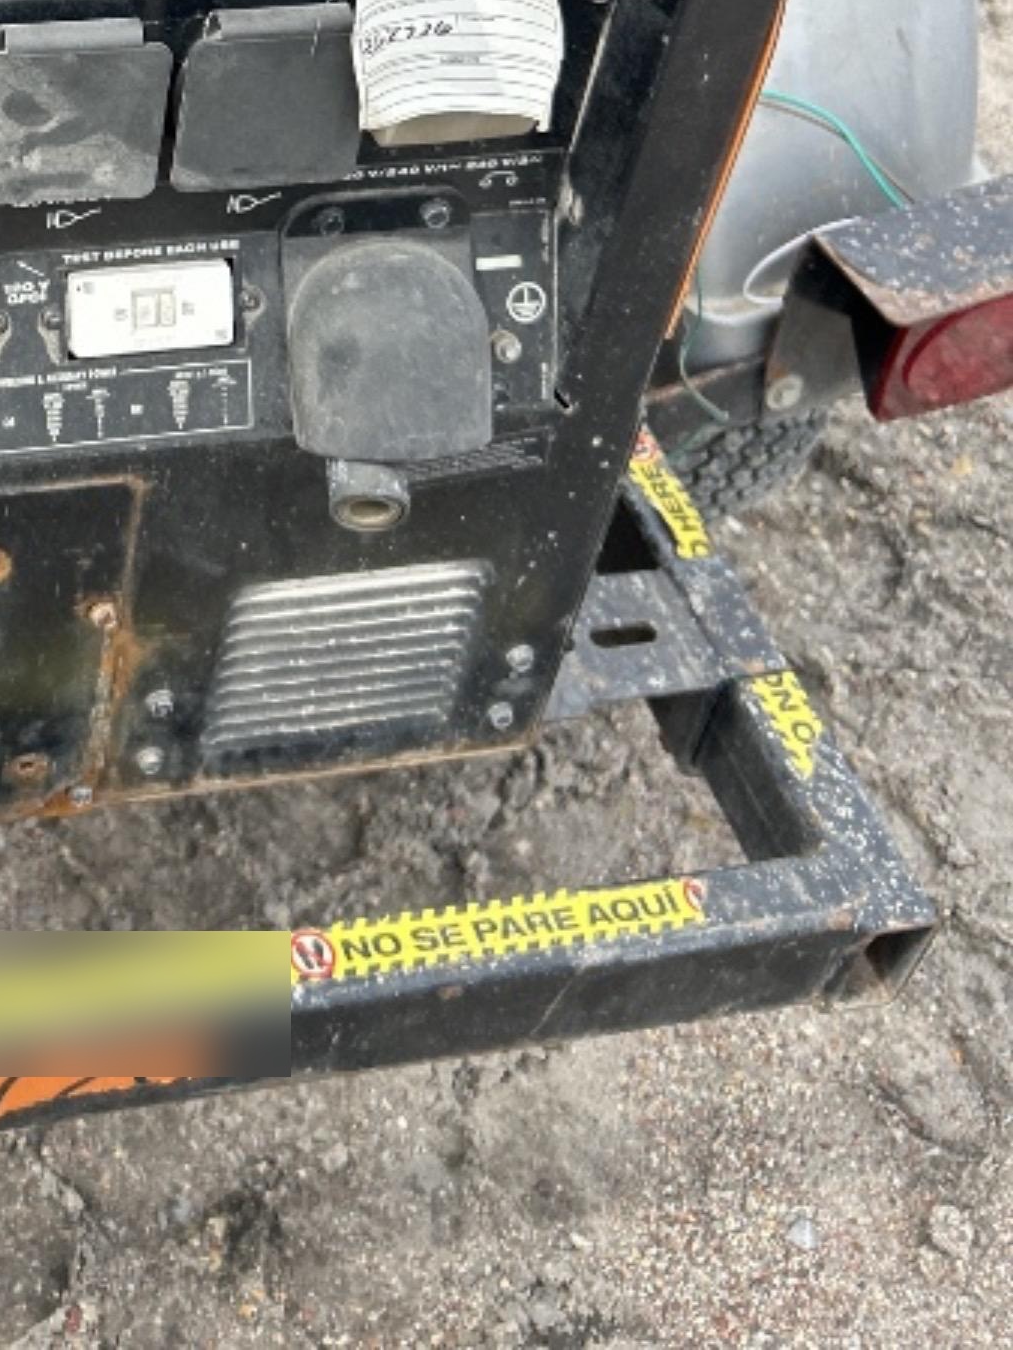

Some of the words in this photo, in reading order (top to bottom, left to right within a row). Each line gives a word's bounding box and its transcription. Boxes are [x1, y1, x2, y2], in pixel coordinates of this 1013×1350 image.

[639, 464, 699, 532] HERE
[341, 933, 402, 962] NO
[409, 922, 467, 951] SE
[473, 906, 579, 944] PARE
[589, 886, 682, 927] AQUÍ
